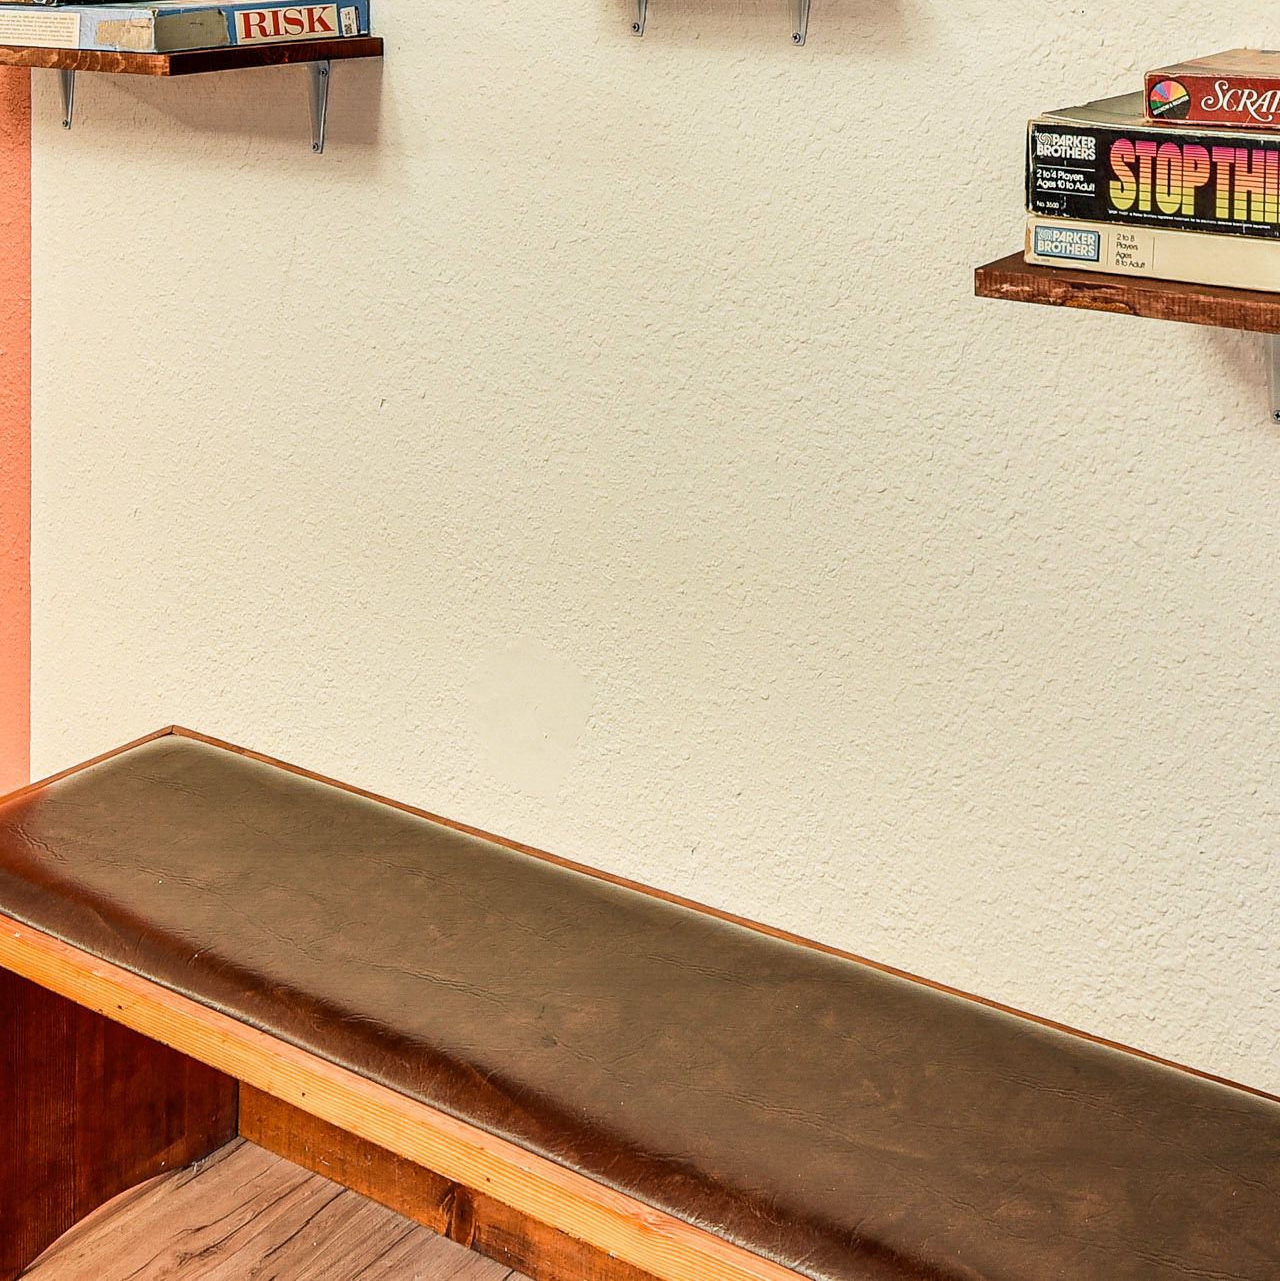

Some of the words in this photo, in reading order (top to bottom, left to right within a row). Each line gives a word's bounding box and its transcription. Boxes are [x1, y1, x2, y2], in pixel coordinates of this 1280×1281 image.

[240, 6, 335, 39] RISK
[1053, 134, 1096, 149] PARKER
[1037, 144, 1096, 160] BROTHERS
[1043, 170, 1050, 178] to
[1058, 171, 1084, 181] Players
[1037, 179, 1056, 189] Ages
[1057, 180, 1065, 188] 10
[1066, 181, 1074, 189] to
[1075, 183, 1095, 191] Adult
[1052, 231, 1095, 245] PARKER
[1038, 240, 1095, 256] BROTHERS
[1116, 242, 1138, 250] Players
[1116, 251, 1132, 259] Ages
[1129, 260, 1145, 268] Adult
